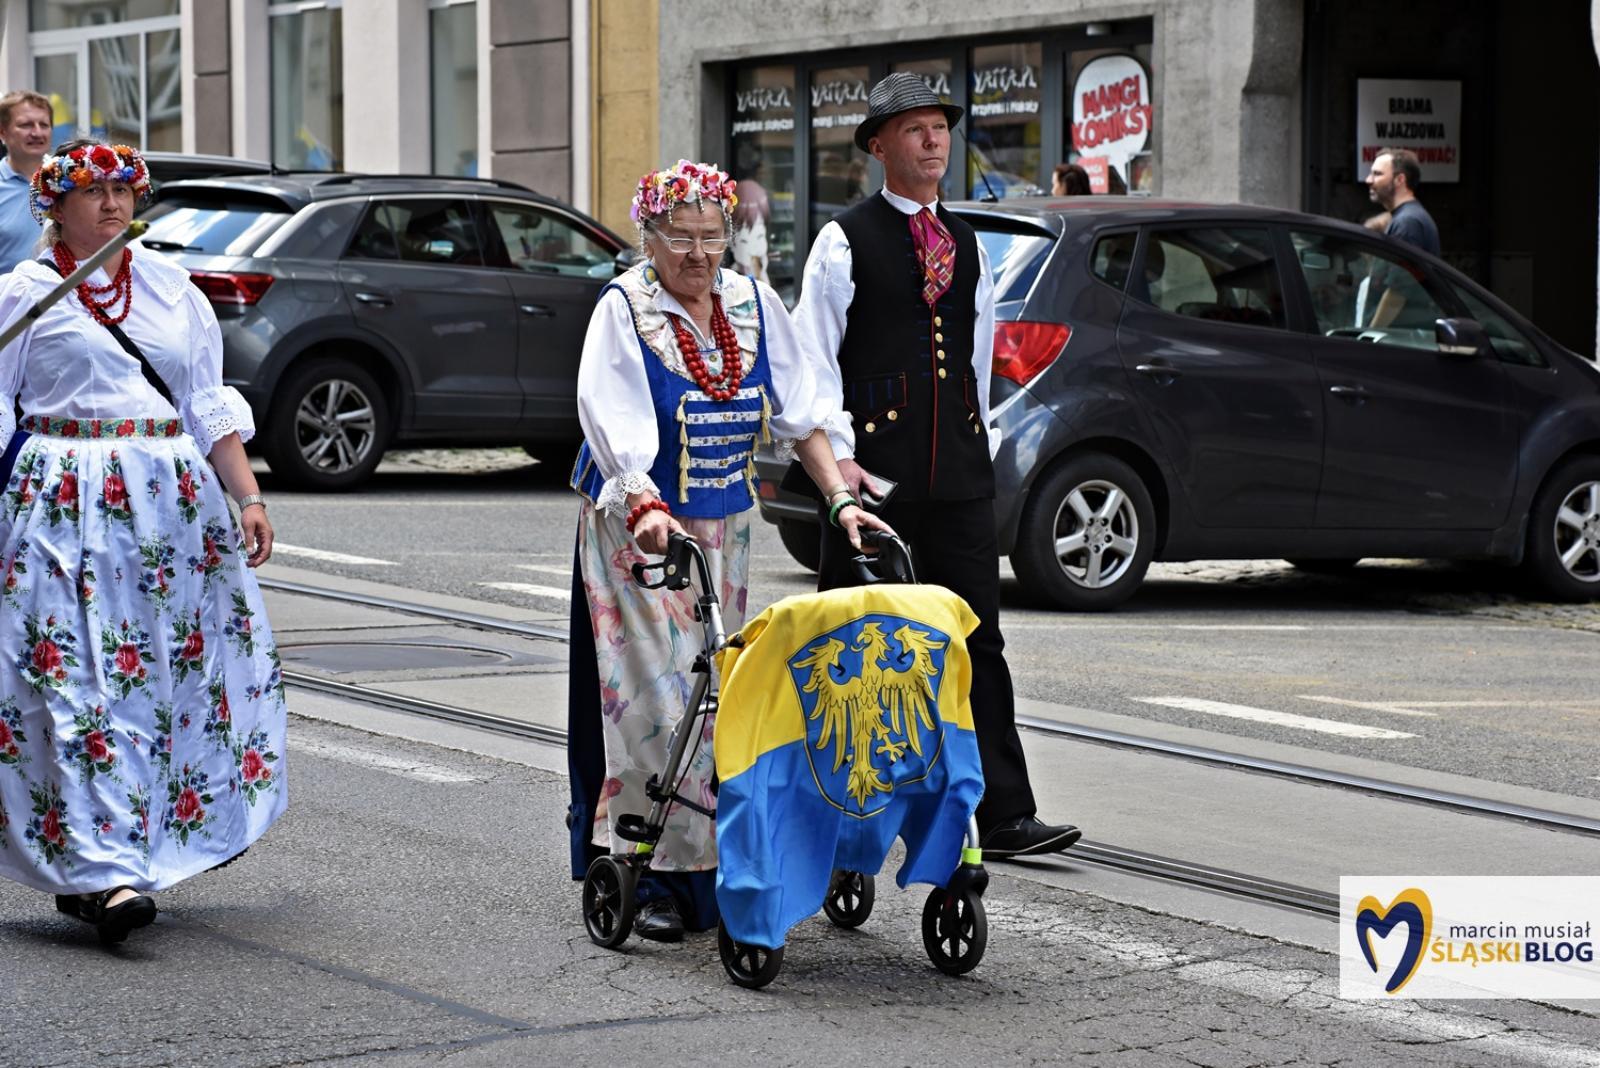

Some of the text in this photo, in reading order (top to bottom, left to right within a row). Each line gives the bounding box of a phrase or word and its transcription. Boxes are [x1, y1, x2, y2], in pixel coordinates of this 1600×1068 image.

[1082, 75, 1140, 118] MANGI
[1388, 97, 1433, 115] BRAMA
[1375, 122, 1446, 139] WJAZDOWA
